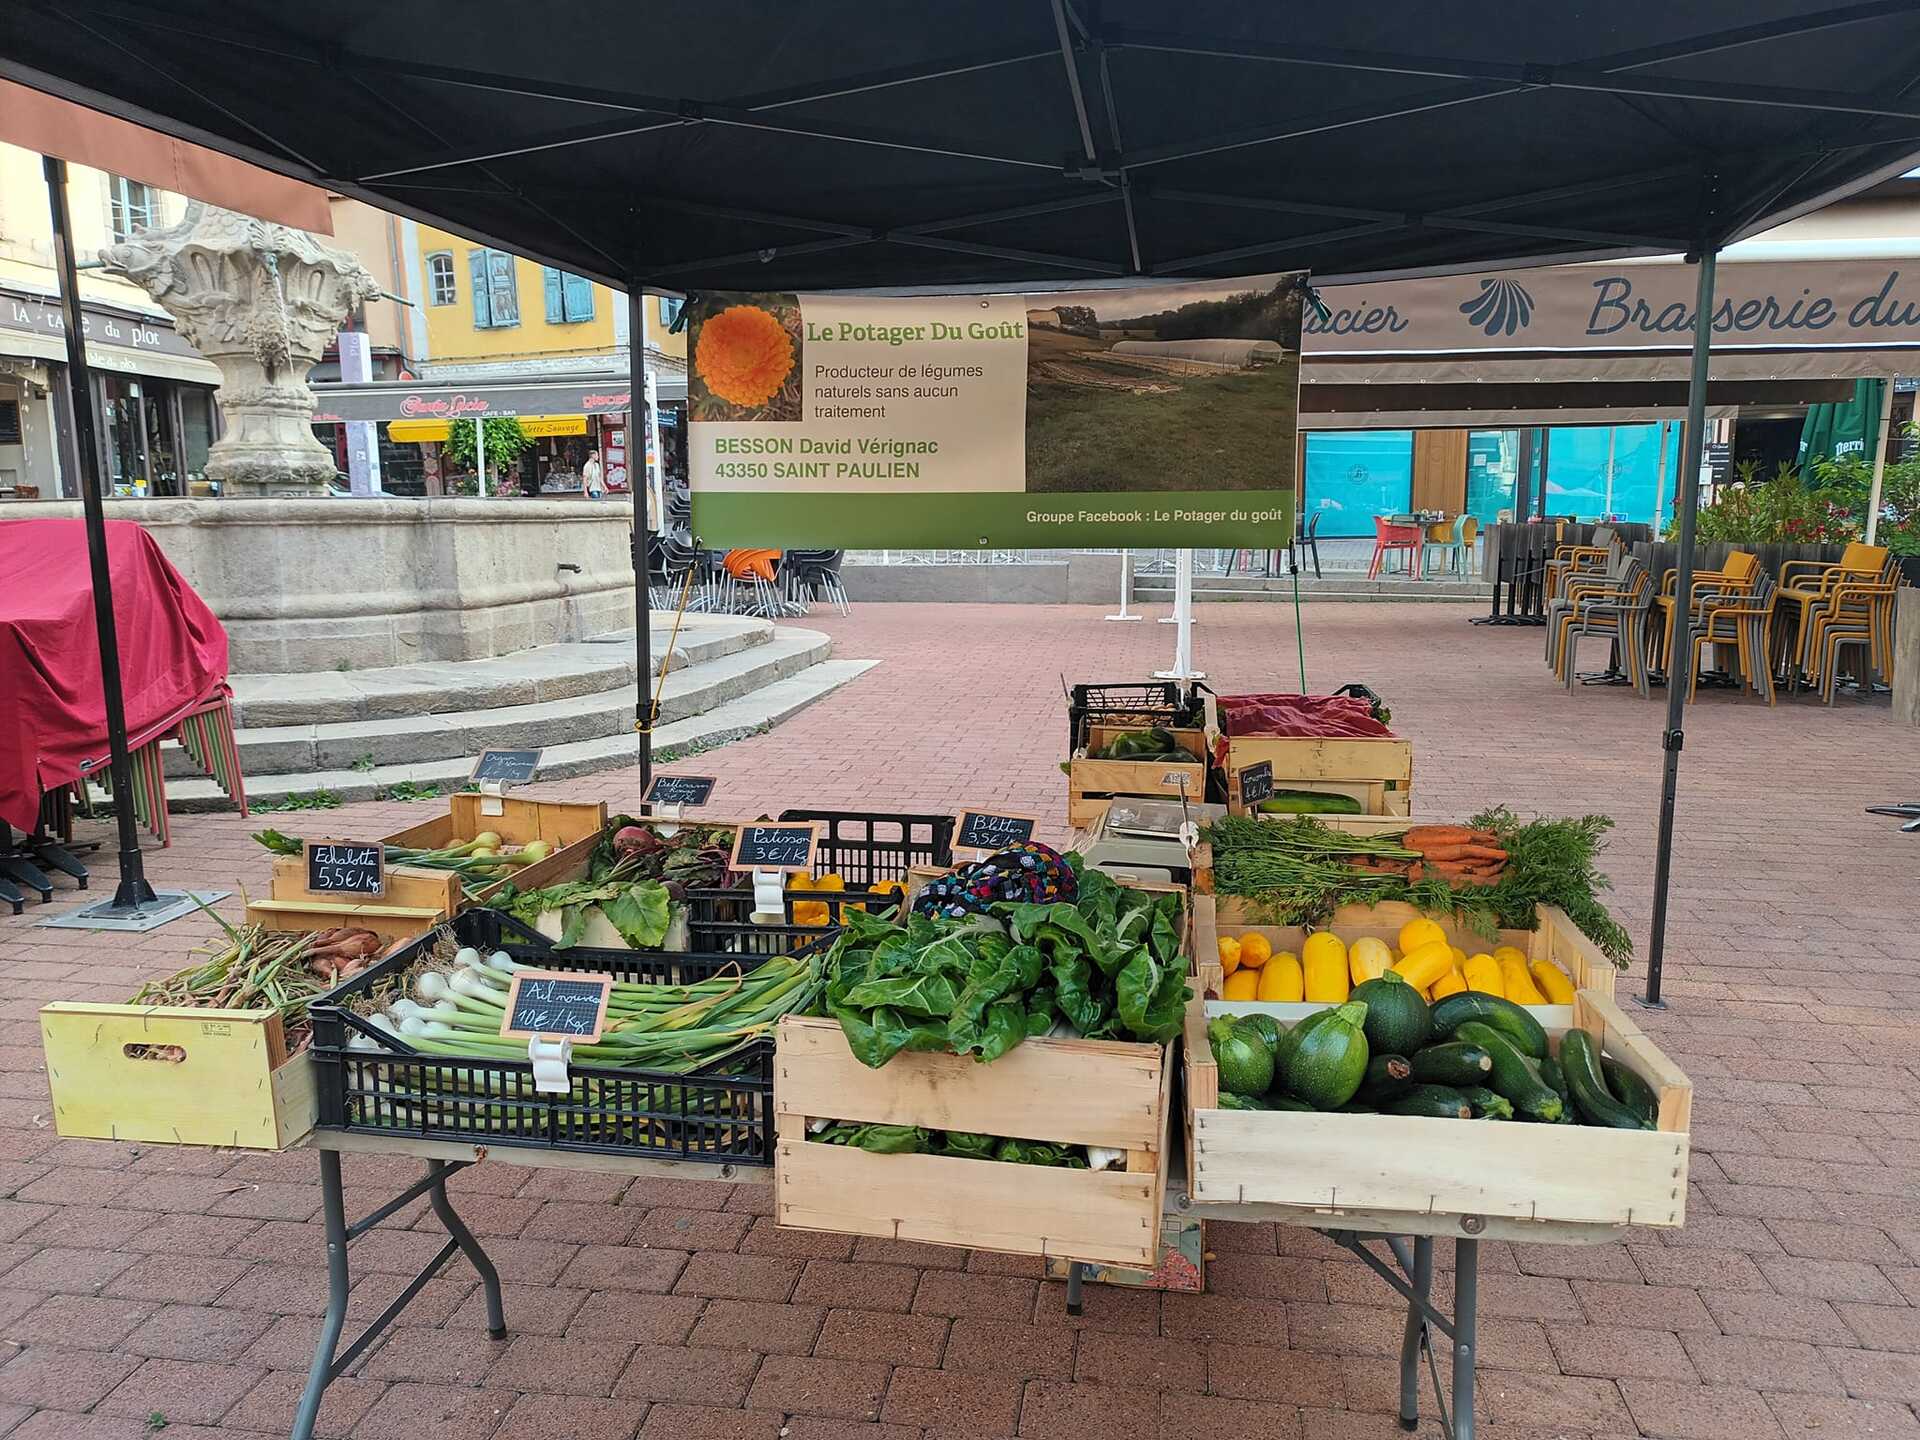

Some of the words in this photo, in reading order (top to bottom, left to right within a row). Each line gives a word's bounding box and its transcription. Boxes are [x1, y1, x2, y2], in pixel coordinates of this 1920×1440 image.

[1585, 277, 1837, 335] Braserie
[105, 320, 121, 339] du
[132, 324, 161, 348] plot
[807, 322, 834, 342] Le
[838, 322, 926, 346] Potager
[930, 322, 963, 341] Du
[967, 320, 1025, 341] Goût
[815, 364, 894, 379] Producteur
[898, 364, 917, 379] de
[921, 363, 983, 381] légumes
[815, 385, 872, 399] naturels
[875, 386, 910, 399] sans
[913, 385, 959, 399] aucun
[815, 405, 886, 419] traitement
[715, 438, 793, 454] BESSON
[800, 438, 851, 454] David
[857, 437, 938, 458] Vérignac
[715, 462, 768, 478] 43350
[773, 462, 830, 478] SAINT
[836, 462, 920, 478] PAULIEN
[1026, 510, 1075, 525] Groupe
[1078, 510, 1142, 523] Facebook
[1154, 509, 1171, 521] Le
[1174, 509, 1226, 524] Potager
[1229, 509, 1247, 521] du
[1251, 508, 1283, 524] goût
[968, 831, 1016, 847] 3,5€/
[526, 980, 555, 1003] Ail
